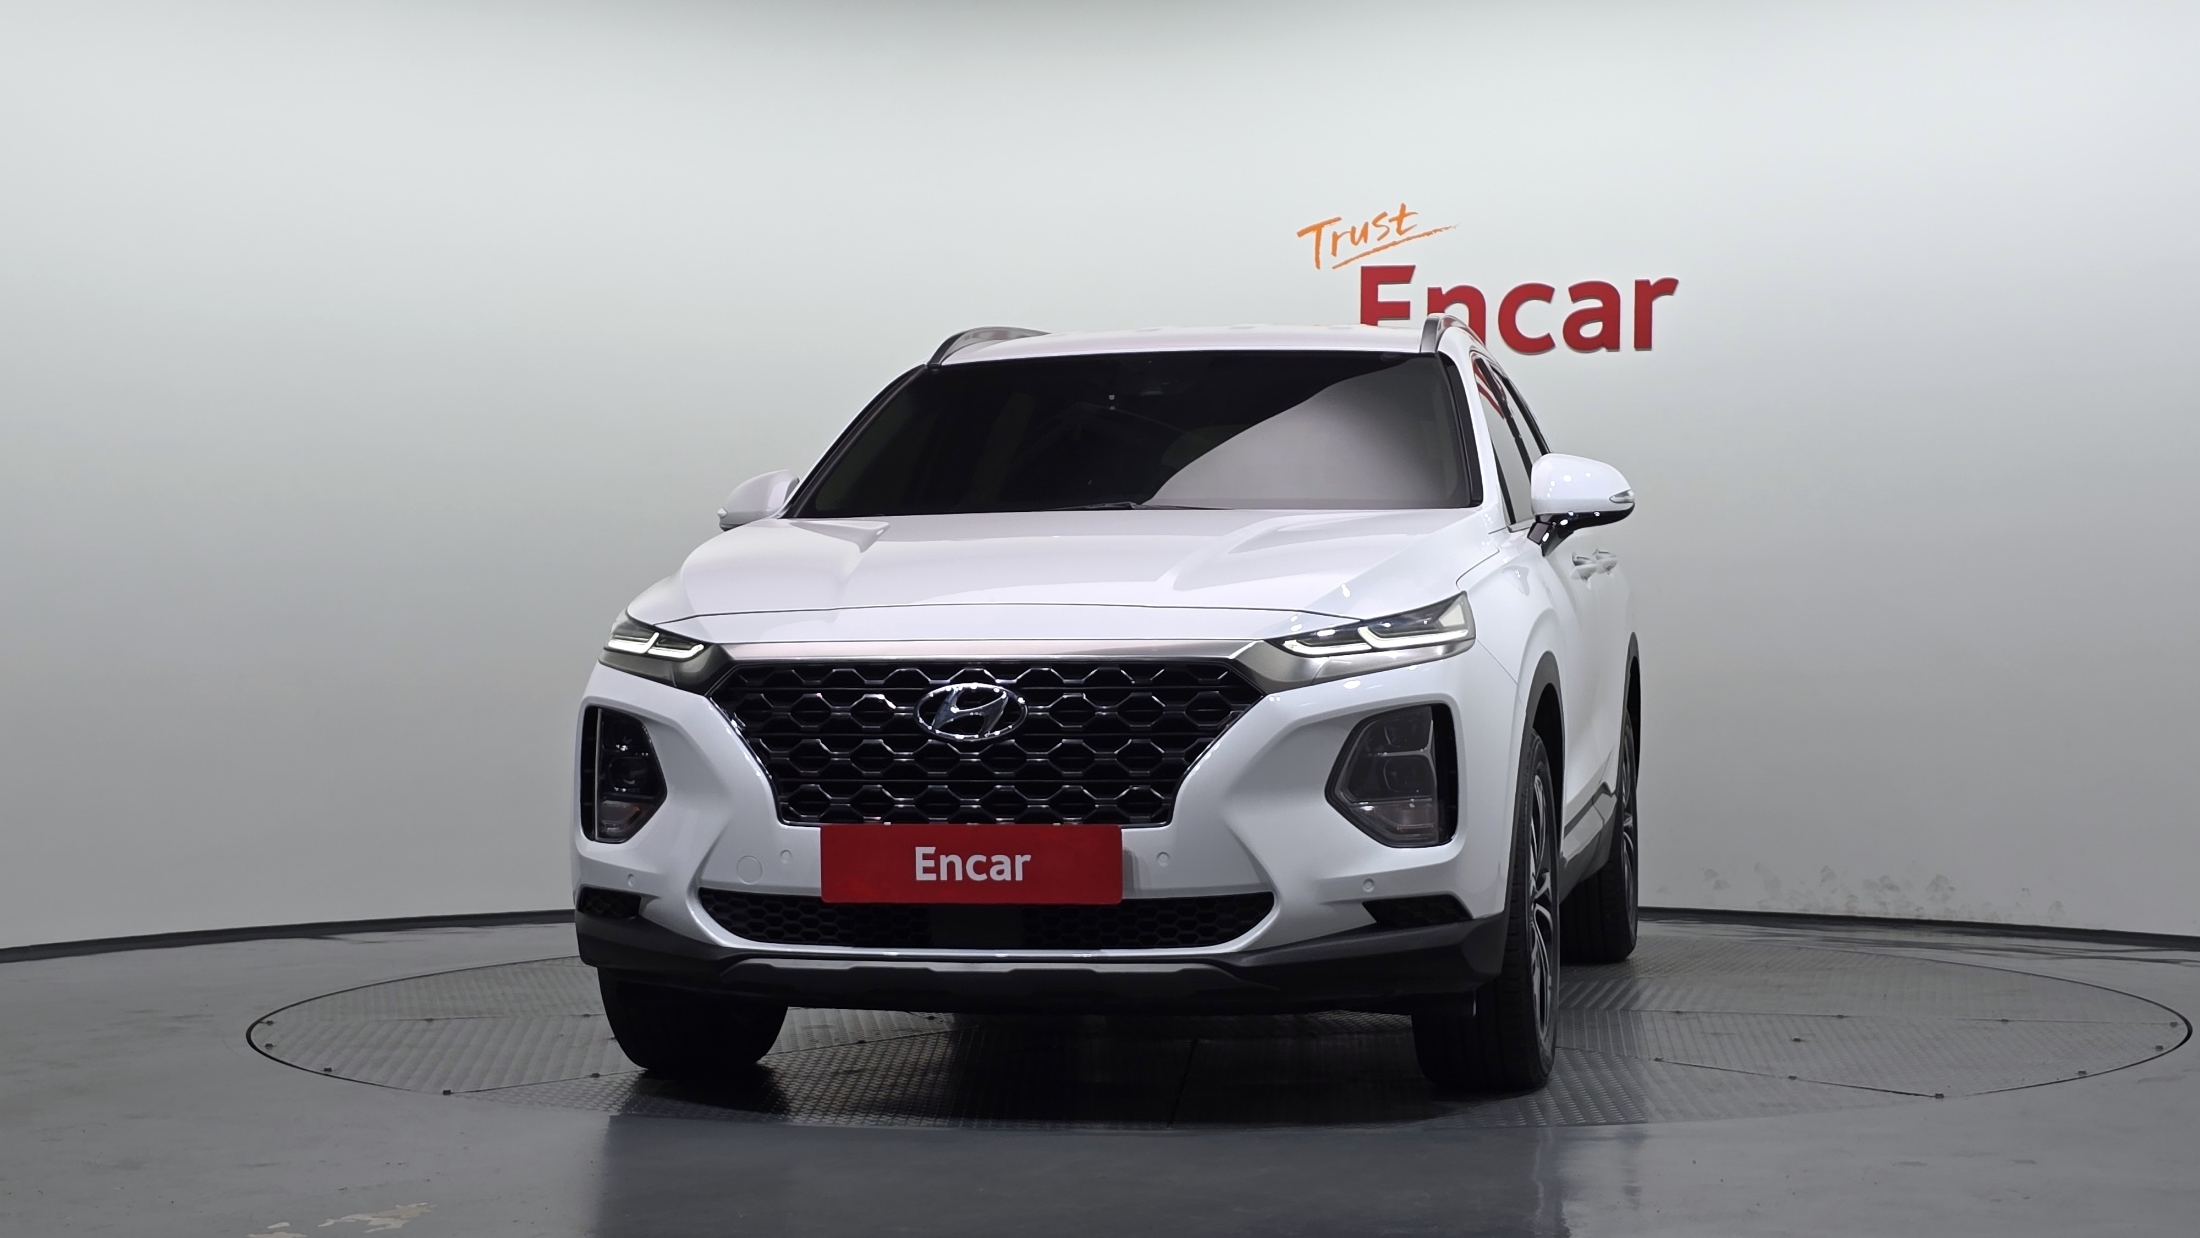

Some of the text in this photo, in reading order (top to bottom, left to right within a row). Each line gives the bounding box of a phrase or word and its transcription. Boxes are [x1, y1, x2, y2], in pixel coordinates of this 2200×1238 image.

[1297, 203, 1420, 270] Trust
[1360, 264, 1679, 355] Encar
[915, 846, 1032, 882] Encar
